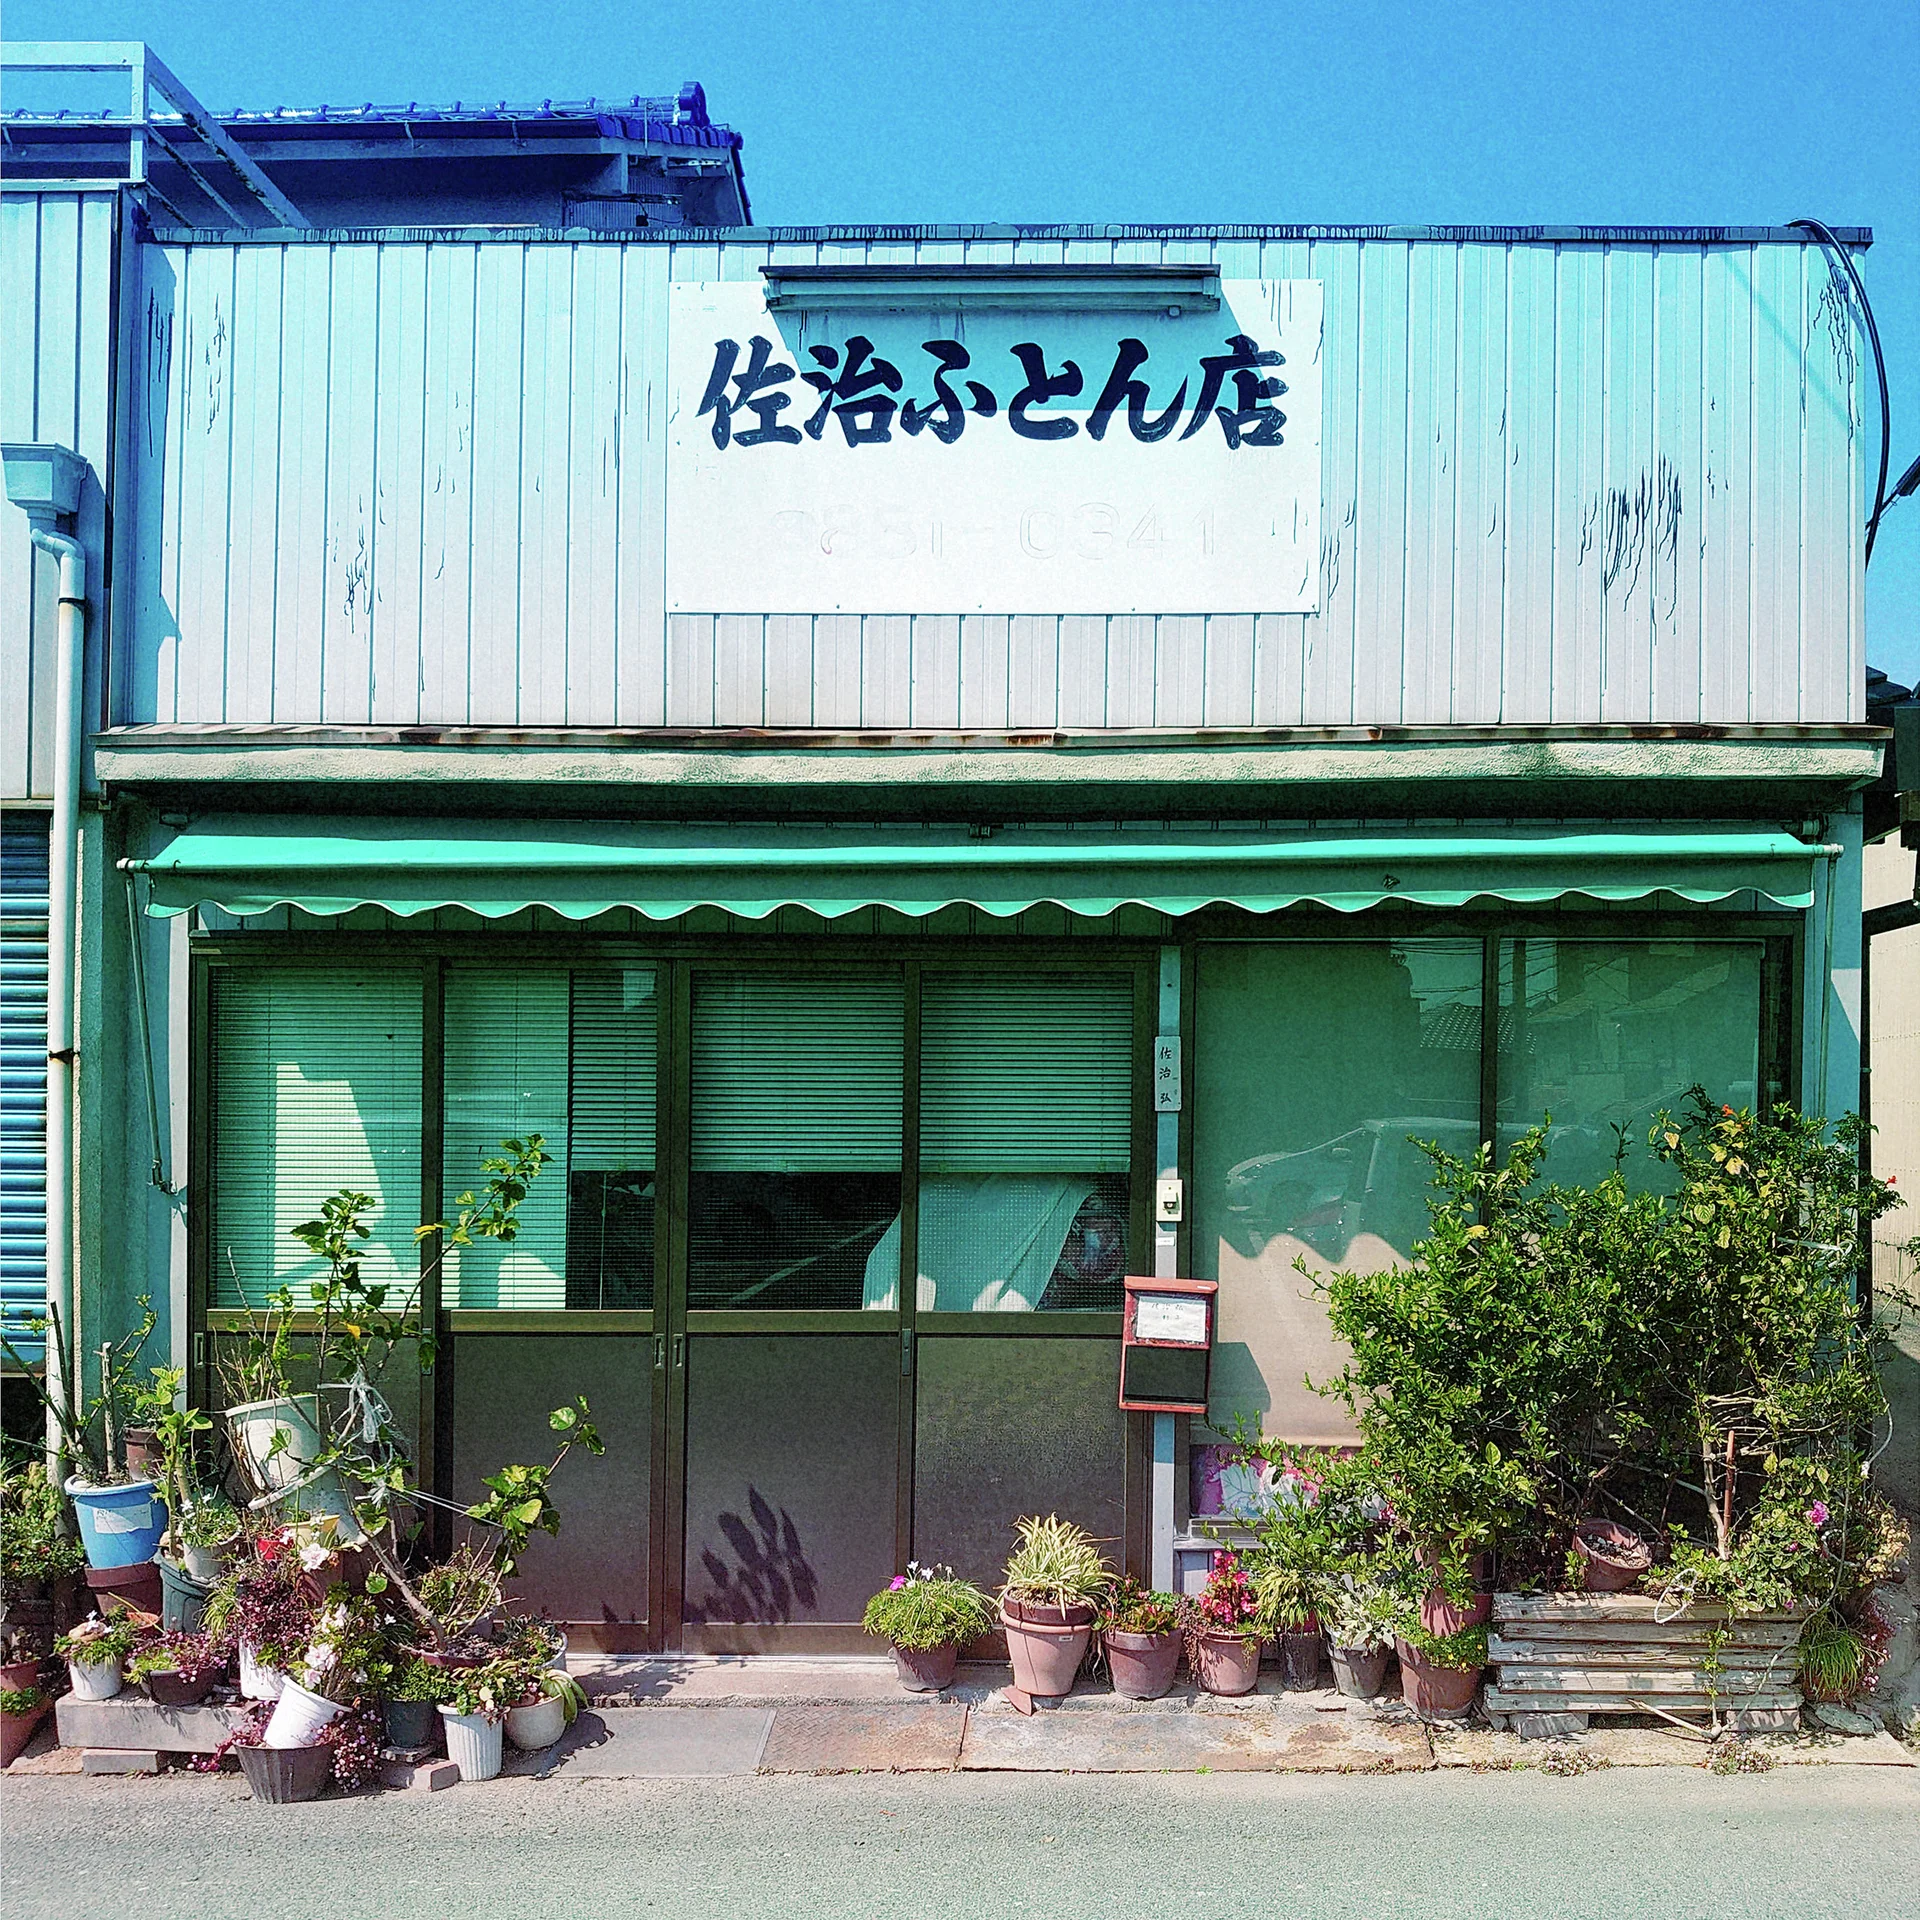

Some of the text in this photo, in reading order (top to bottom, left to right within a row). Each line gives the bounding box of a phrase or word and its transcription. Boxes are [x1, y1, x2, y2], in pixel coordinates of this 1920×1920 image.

[697, 335, 1290, 449] 佐治ふとん店
